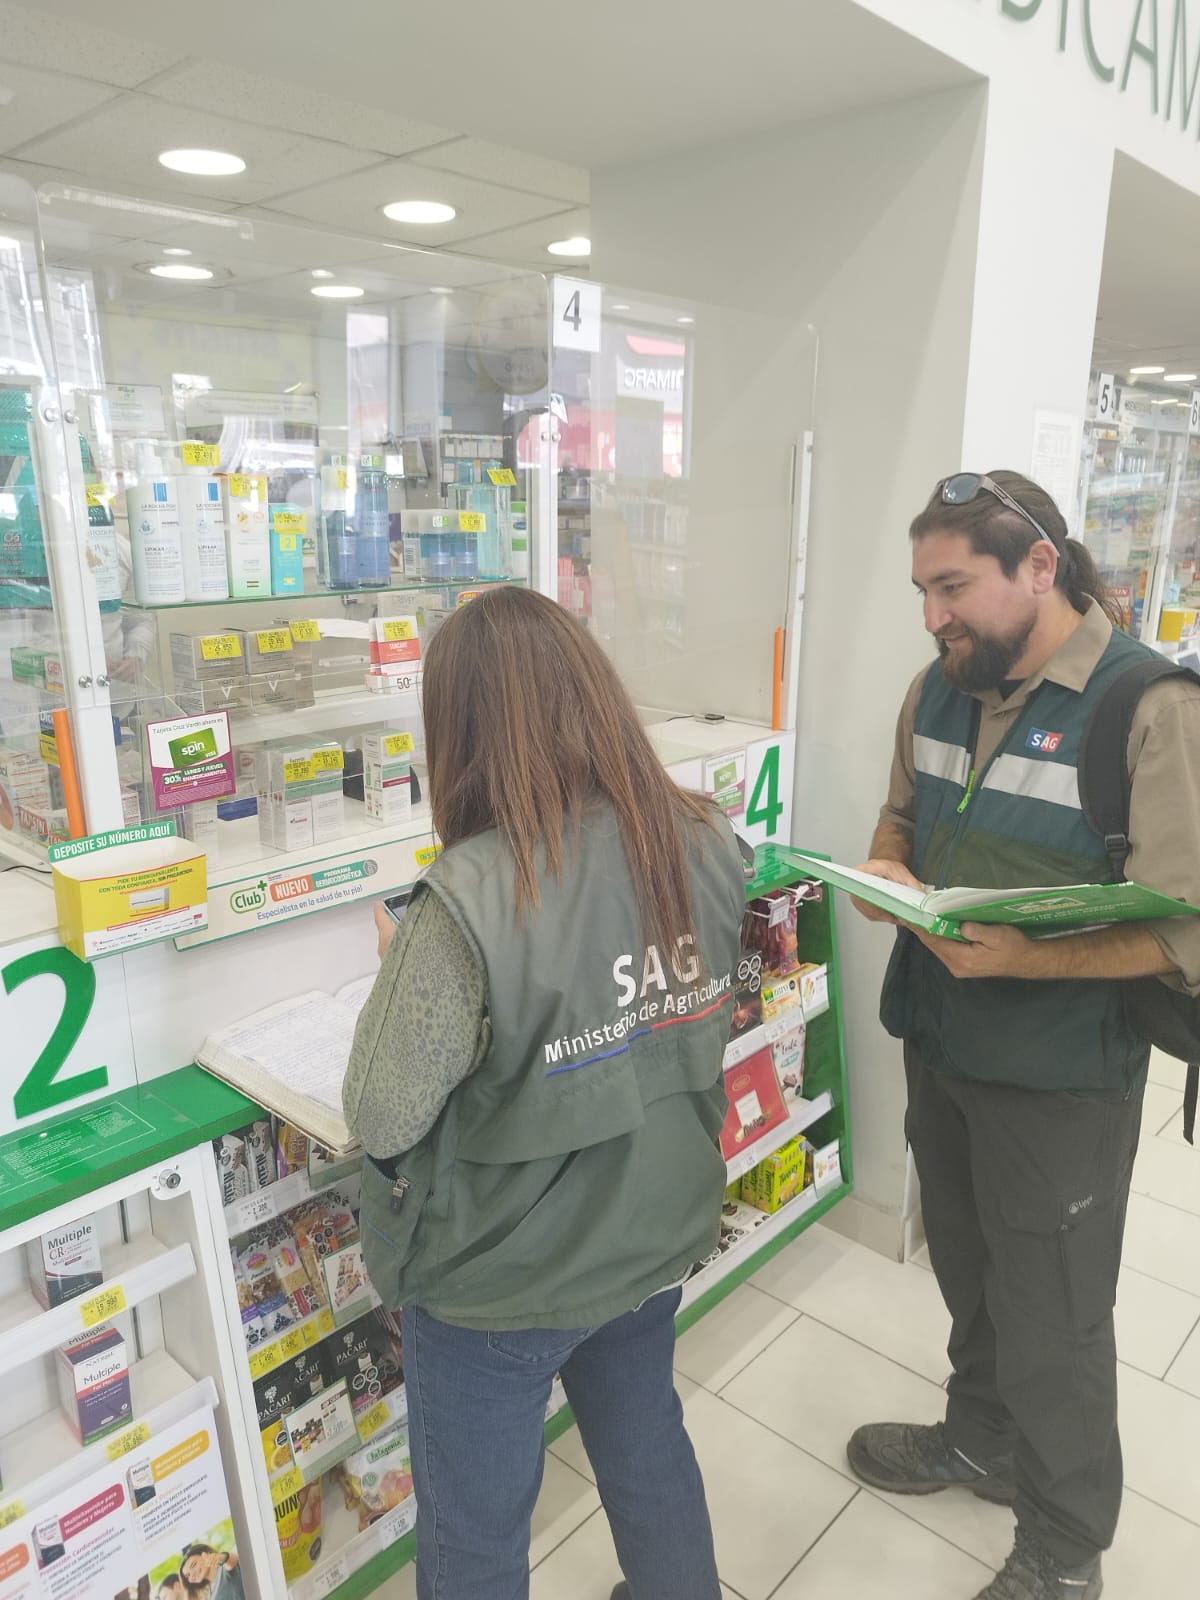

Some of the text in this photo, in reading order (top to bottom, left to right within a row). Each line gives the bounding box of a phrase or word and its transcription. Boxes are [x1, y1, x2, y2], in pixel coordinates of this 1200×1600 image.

[563, 290, 583, 332] 4
[1100, 384, 1110, 414] 5
[1191, 400, 1198, 426] 6
[181, 742, 205, 757] spin
[1031, 733, 1060, 750] SAG
[164, 773, 183, 785] 30%
[746, 744, 784, 838] 4
[53, 840, 95, 860] DEPOSITE
[96, 837, 107, 848] SU
[108, 828, 147, 845] NÚMERO
[149, 822, 170, 838] AQUÍ
[234, 891, 262, 909] Club
[274, 878, 310, 899] NUEVO
[256, 902, 299, 921] Especialista
[299, 901, 308, 909] en
[308, 898, 315, 906] la
[316, 892, 335, 904] salud
[335, 890, 343, 898] de
[344, 888, 350, 896] tu
[612, 934, 700, 1008] SAG
[544, 972, 732, 1064] Ministerio de Agricultura
[1, 946, 109, 1120] 2
[48, 1225, 93, 1250] Multiple
[49, 1246, 65, 1260] CR
[68, 1325, 107, 1346] Multiple
[336, 1341, 368, 1363] PACARI
[84, 1362, 121, 1385] Multiple
[257, 1393, 293, 1421] PACARI
